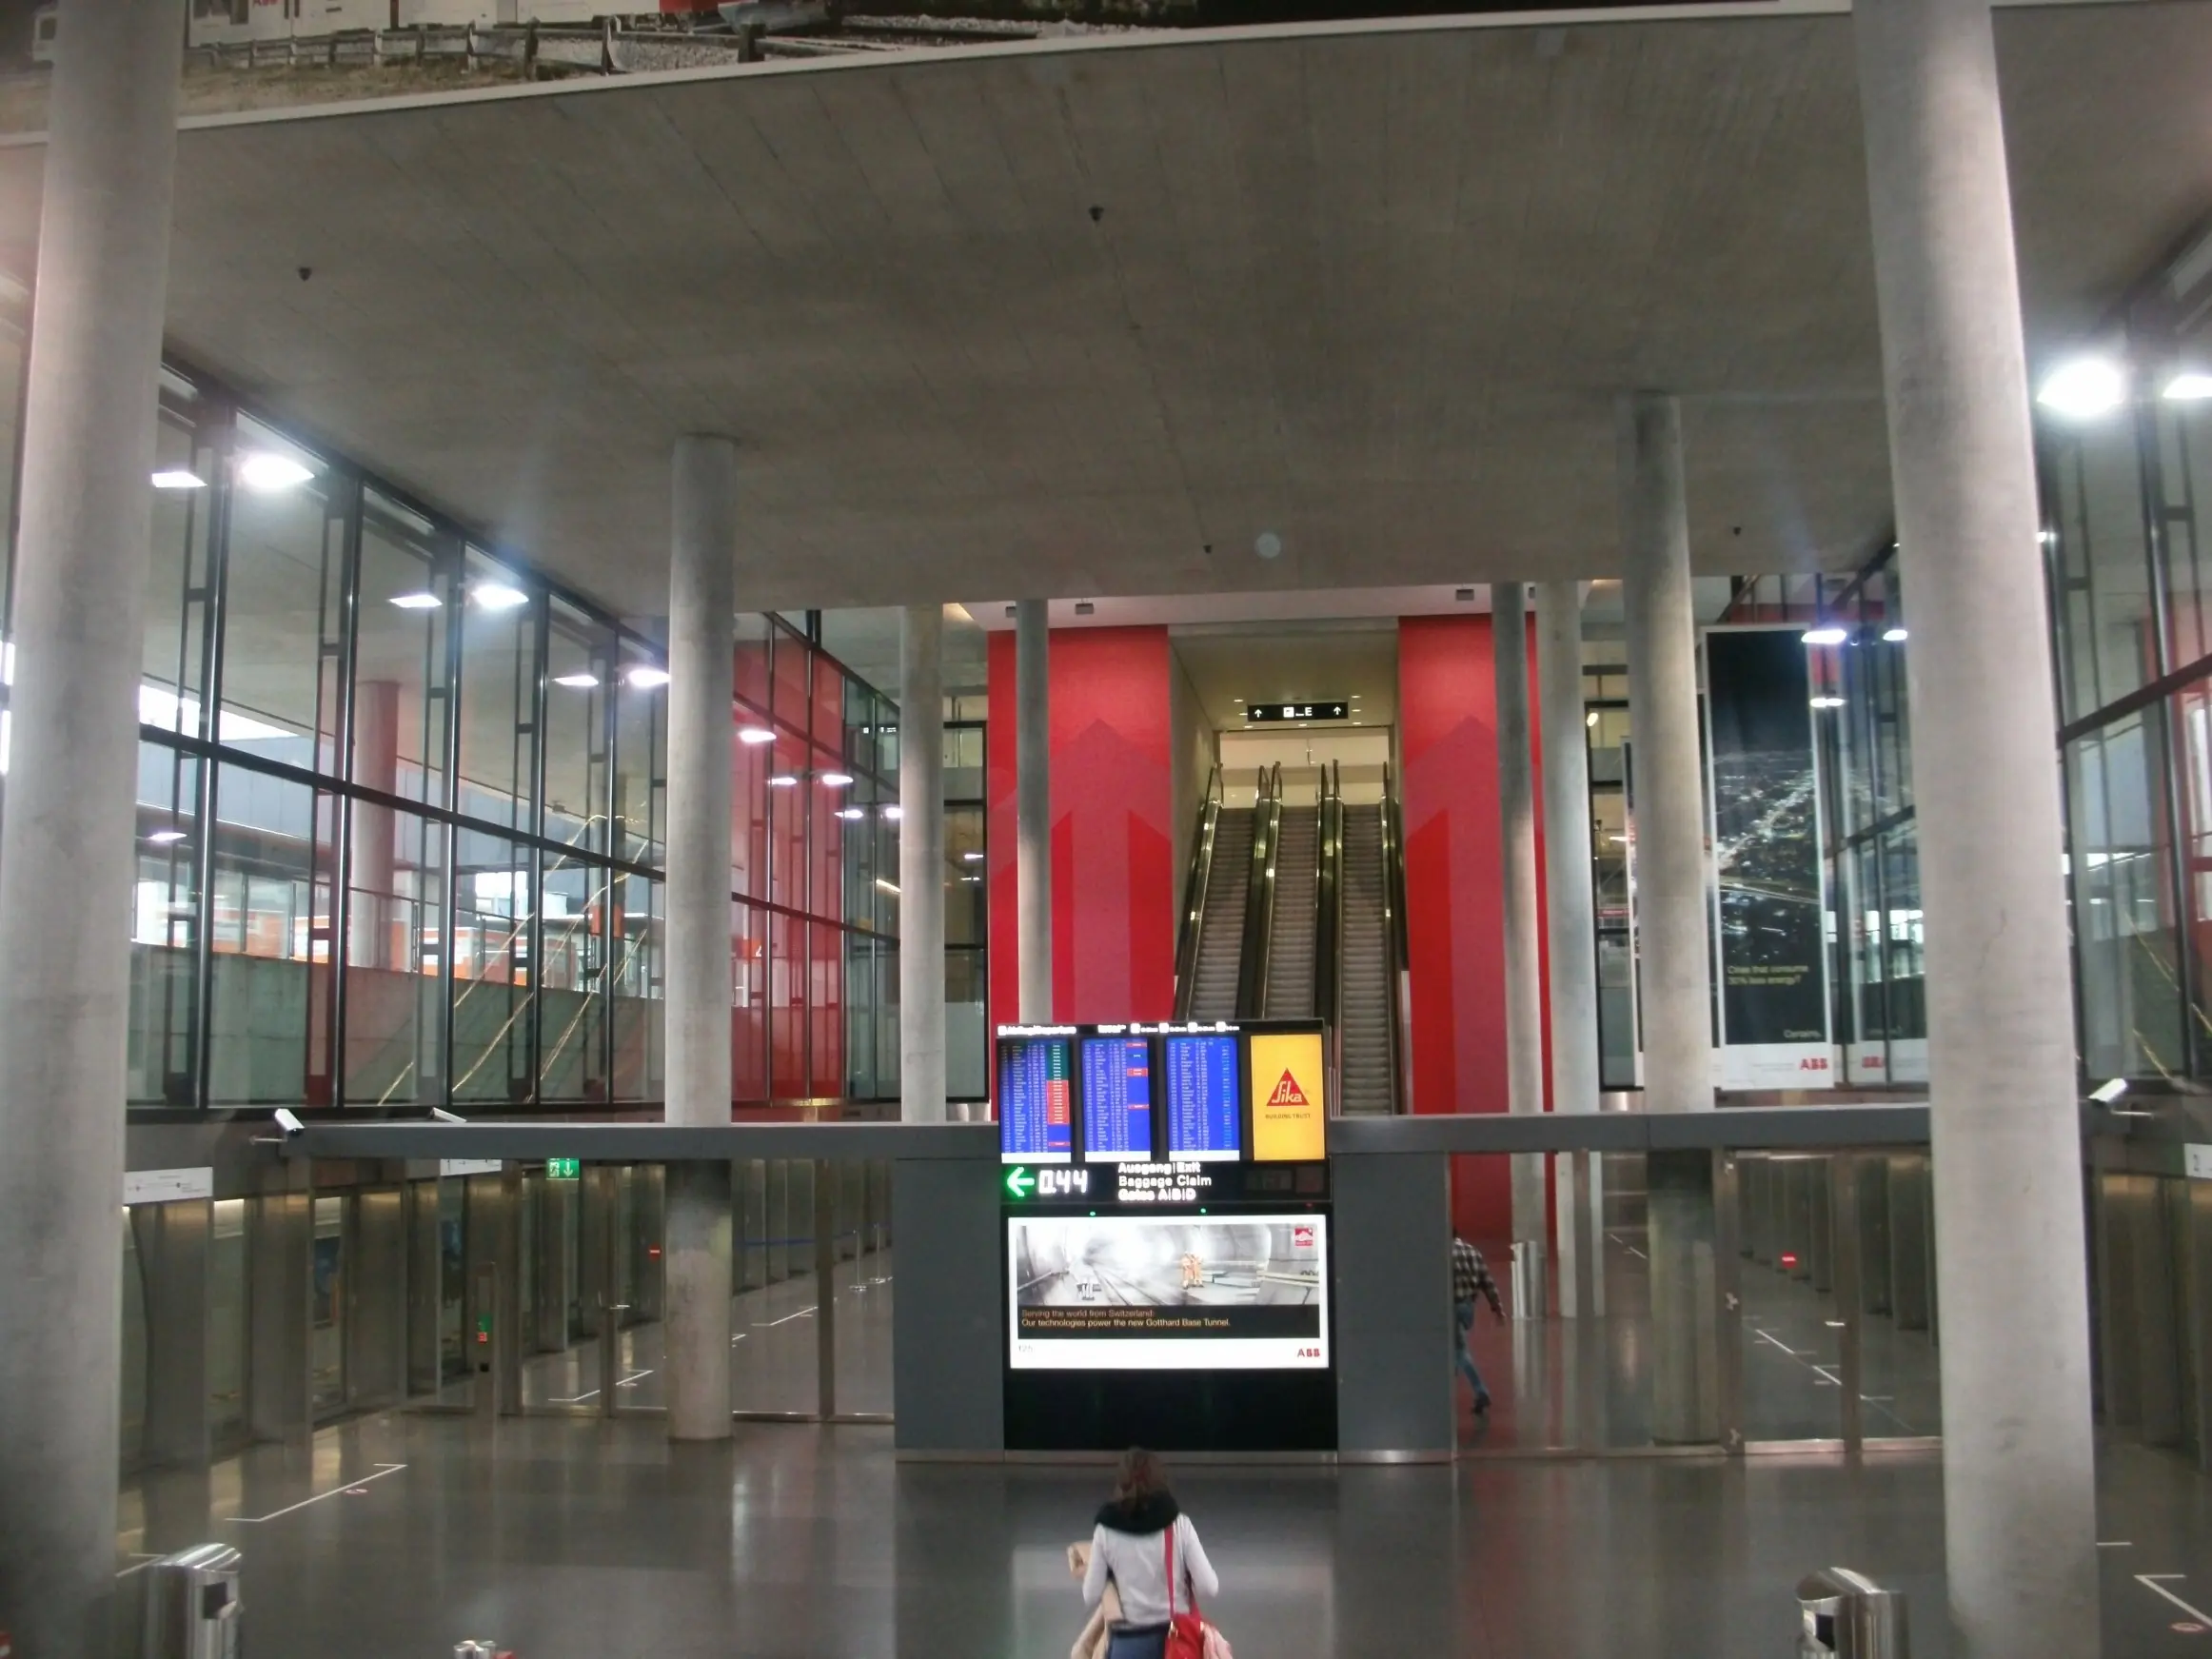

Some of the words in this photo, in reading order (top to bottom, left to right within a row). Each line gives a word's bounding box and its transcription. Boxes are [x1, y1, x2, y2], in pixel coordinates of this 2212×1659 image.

[1305, 707, 1313, 716] E
[1800, 1057, 1827, 1070] ABB
[1271, 1080, 1302, 1103] Sika
[1118, 1175, 1173, 1189] Baggage
[1176, 1174, 1212, 1186] Claim
[1117, 1188, 1155, 1201] Gates
[1052, 1310, 1064, 1318] the
[1066, 1310, 1087, 1318] world
[1089, 1310, 1107, 1318] from
[1021, 1318, 1036, 1327] Our
[1037, 1318, 1086, 1329] technologies
[1088, 1319, 1112, 1329] power
[1114, 1318, 1126, 1327] the
[1146, 1318, 1180, 1327] Gotthard
[1182, 1318, 1202, 1327] Base
[1297, 1348, 1320, 1357] ABB
